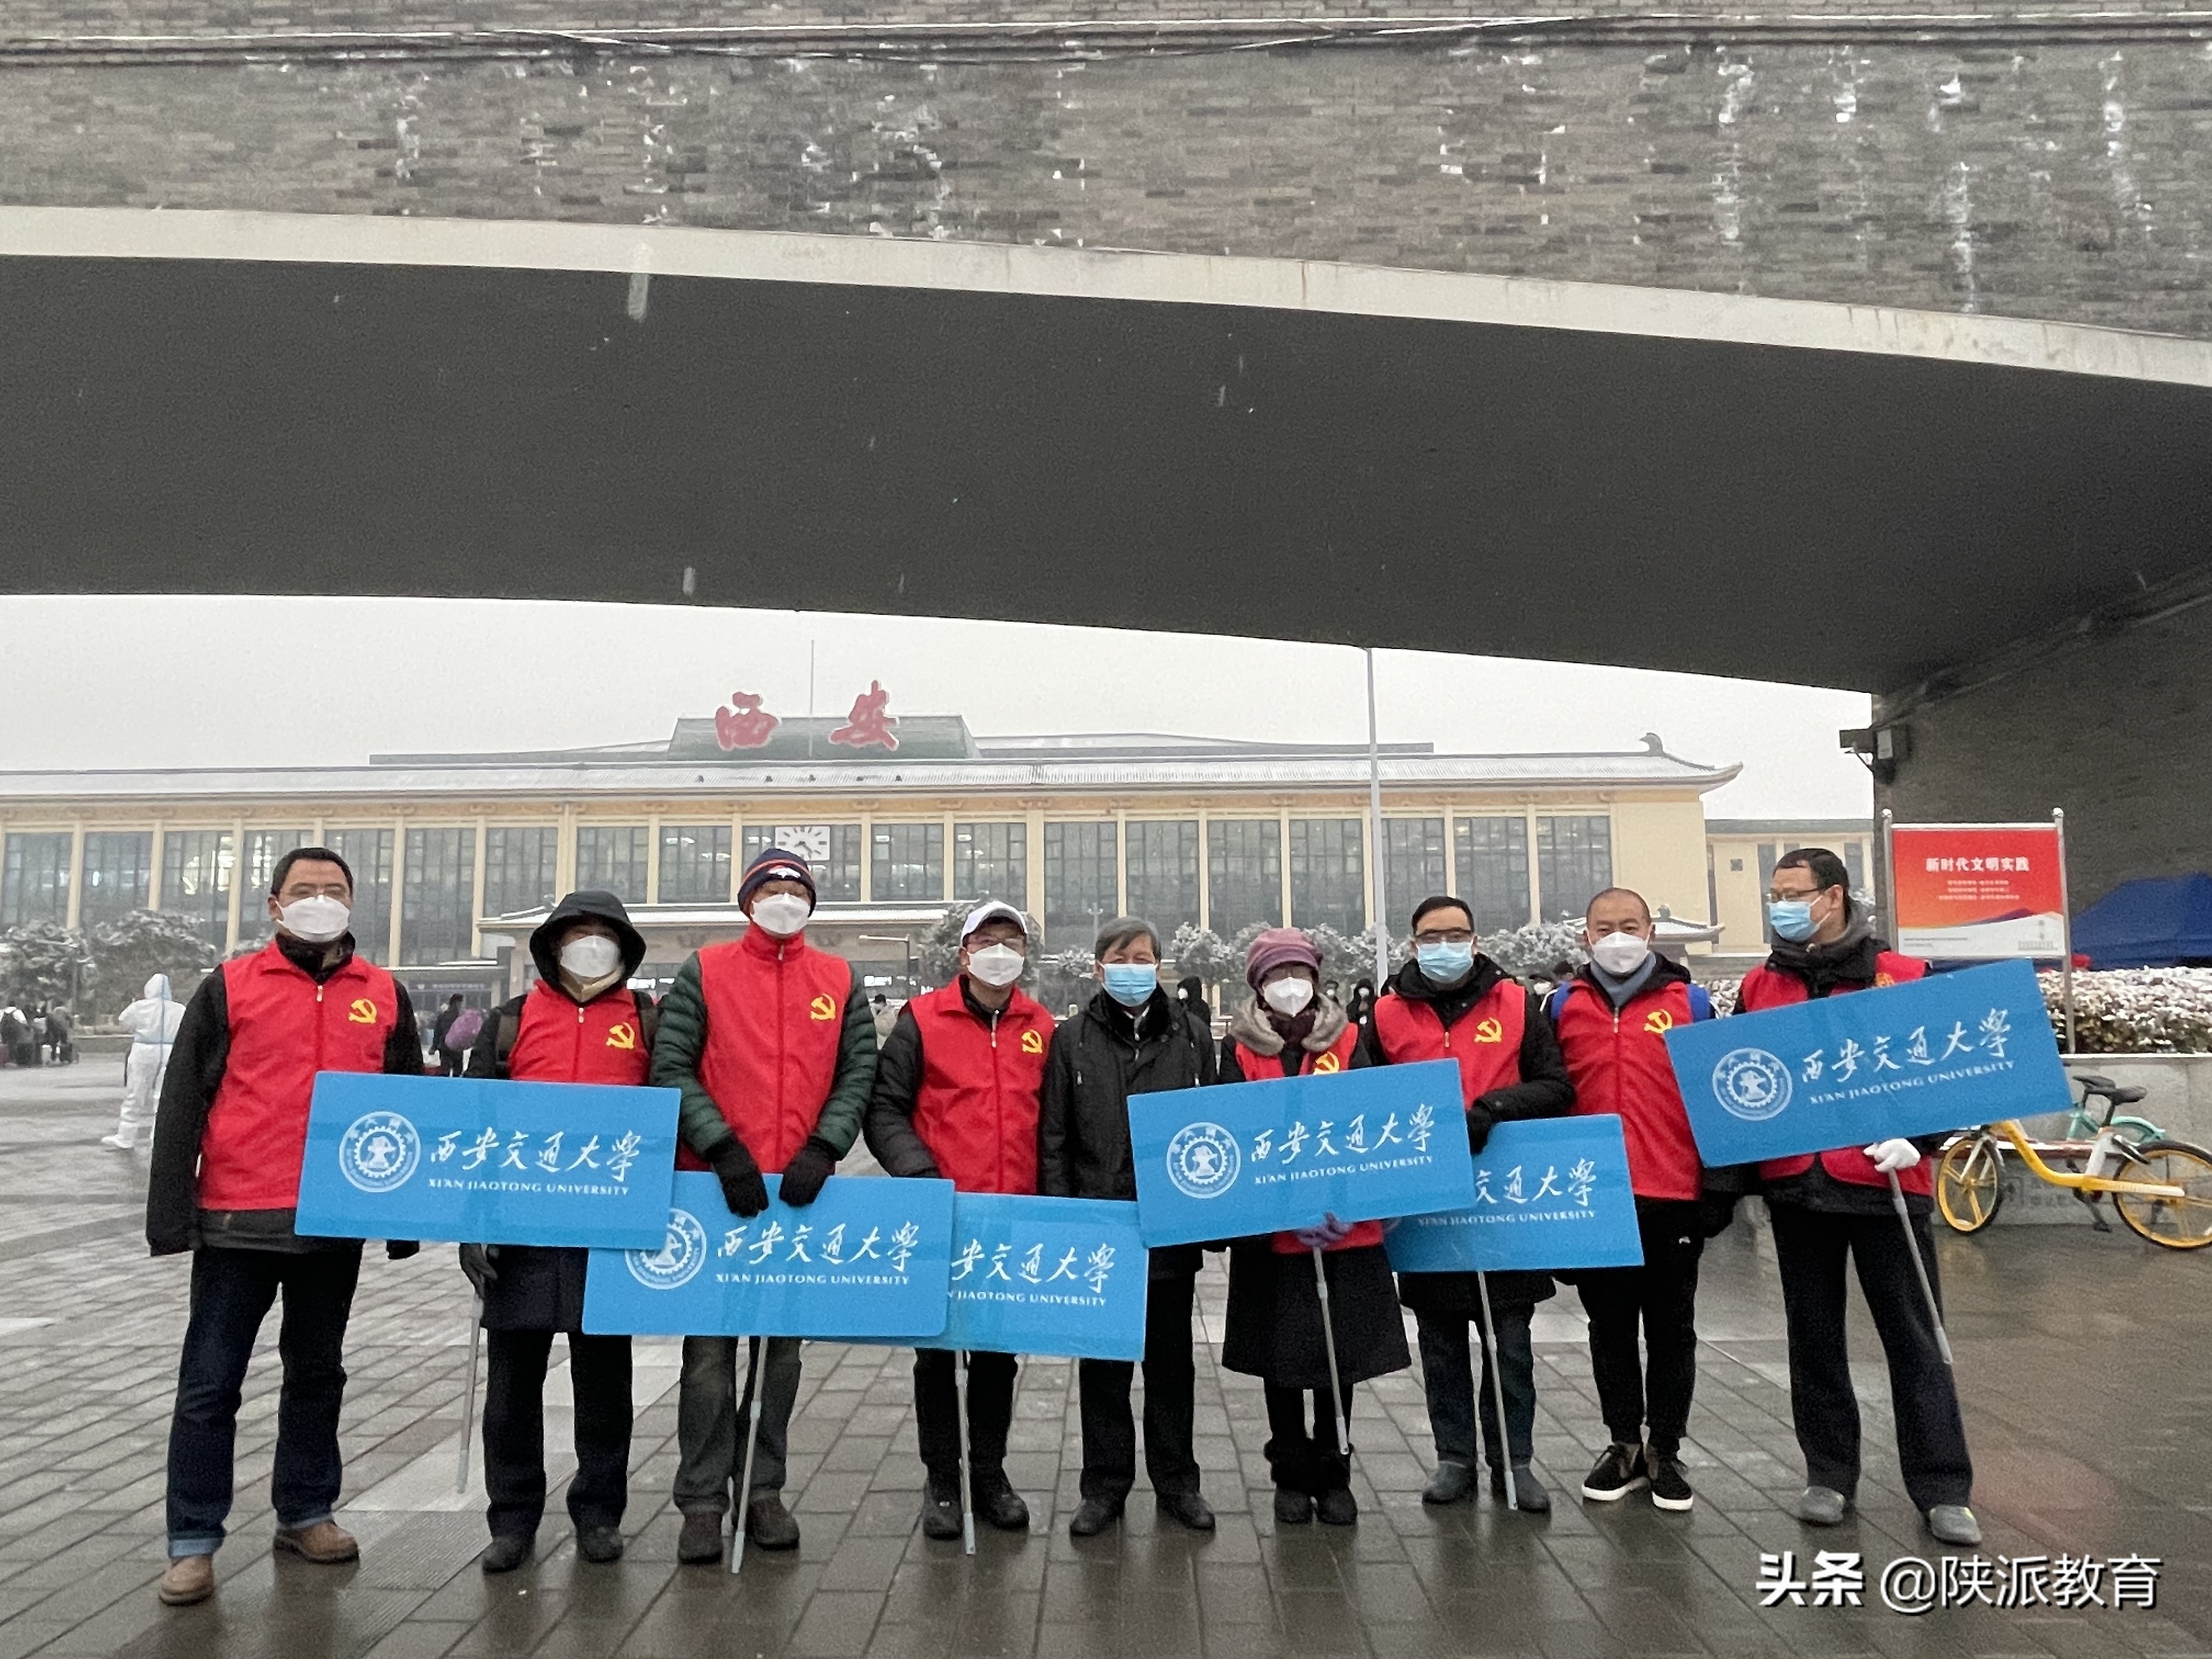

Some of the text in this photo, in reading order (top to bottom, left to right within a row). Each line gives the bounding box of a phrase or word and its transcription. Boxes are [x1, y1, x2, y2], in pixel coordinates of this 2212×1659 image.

[1926, 856, 2030, 872] 新时代文明实践
[1849, 1077, 1925, 1099] JIAOTONG
[1928, 1060, 2014, 1084] UNIVERSITY
[1290, 1164, 1357, 1181] JIAOTONG
[1359, 1155, 1433, 1172] UNIVERSITY
[467, 1180, 542, 1192] JIAOTONG
[546, 1182, 629, 1195] UNIVERSITY
[1450, 1214, 1516, 1226] JIAOTONG
[1519, 1210, 1595, 1223] UNIVERSITY
[755, 1274, 827, 1285] JIAOTONG
[831, 1274, 910, 1285] UNIVERSITY
[957, 1290, 1026, 1302] JIAOTONG
[1029, 1293, 1107, 1307] UNIVERSITY
